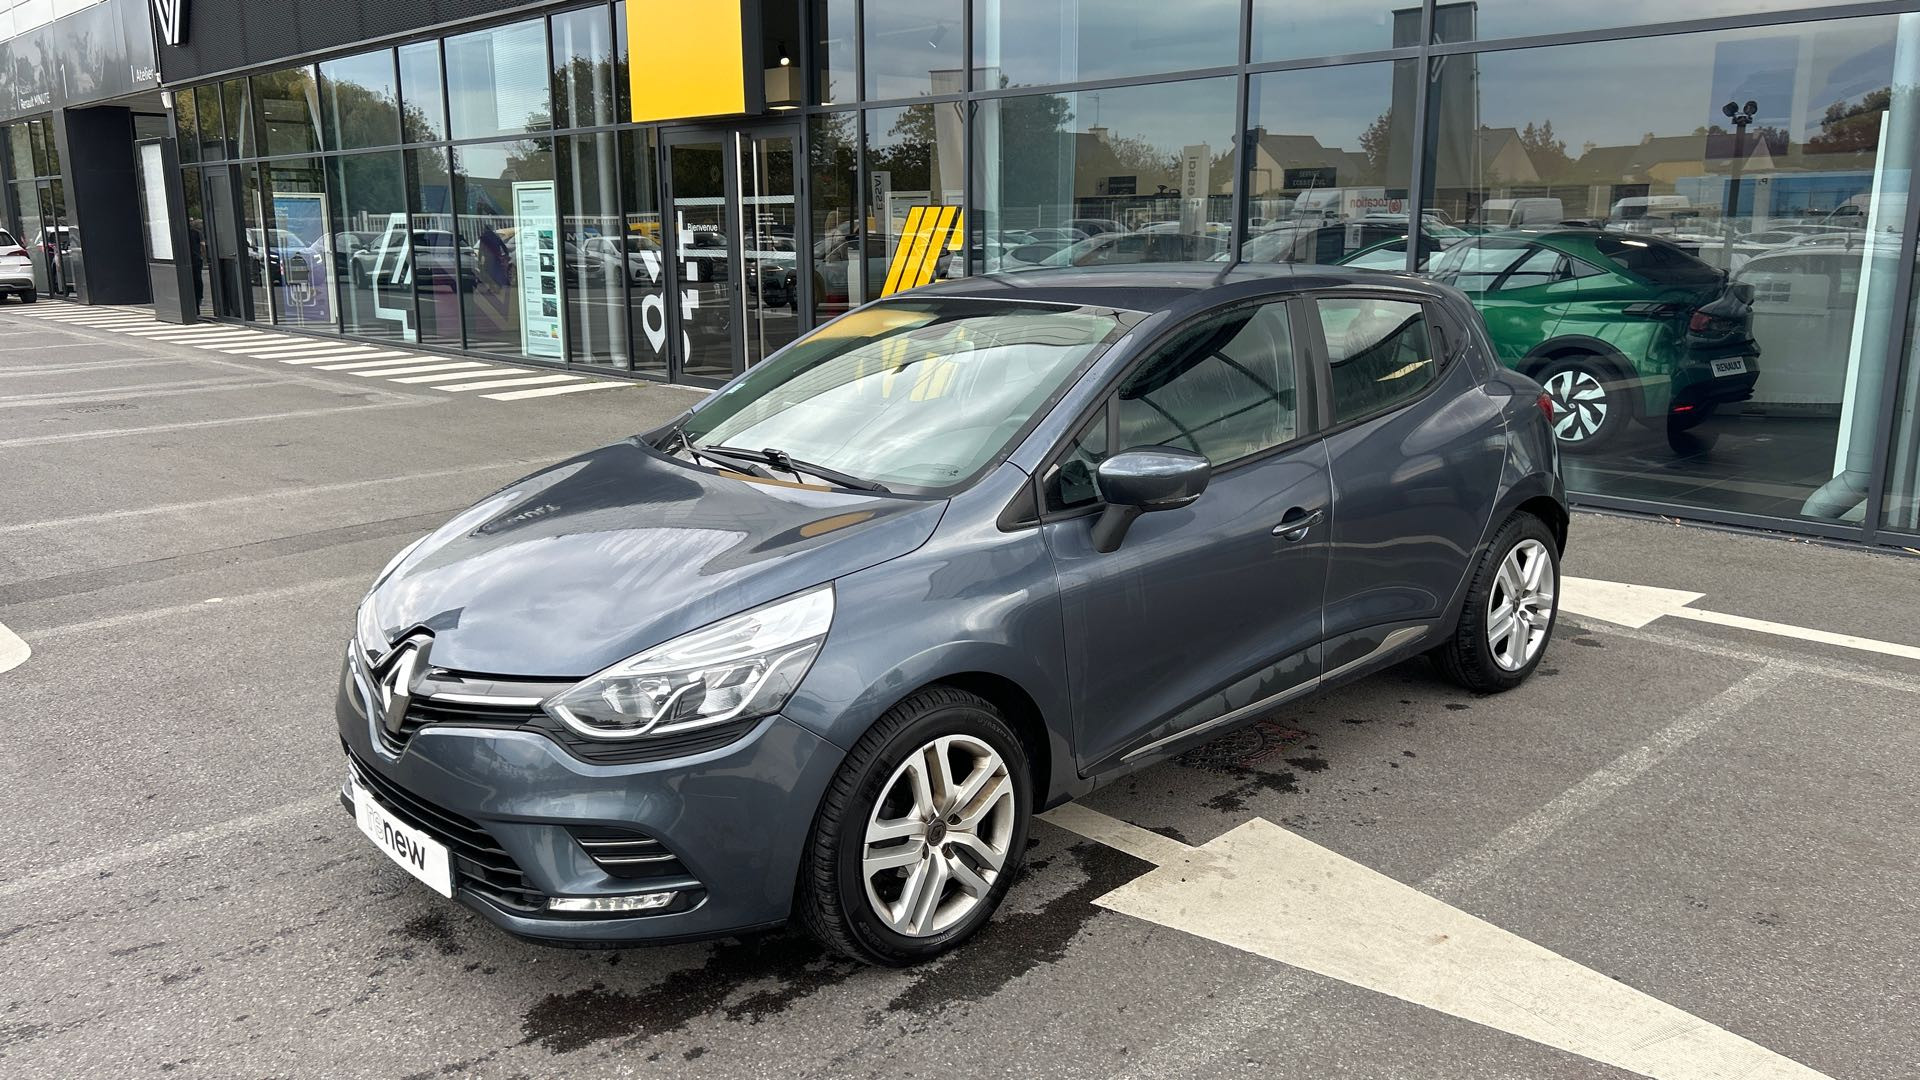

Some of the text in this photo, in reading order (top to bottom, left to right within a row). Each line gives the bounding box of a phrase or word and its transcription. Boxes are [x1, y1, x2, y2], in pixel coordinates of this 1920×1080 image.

[136, 66, 154, 82] Atelier
[687, 222, 718, 232] Bienvenue
[1714, 360, 1742, 373] RENAULT
[366, 803, 426, 872] renew
